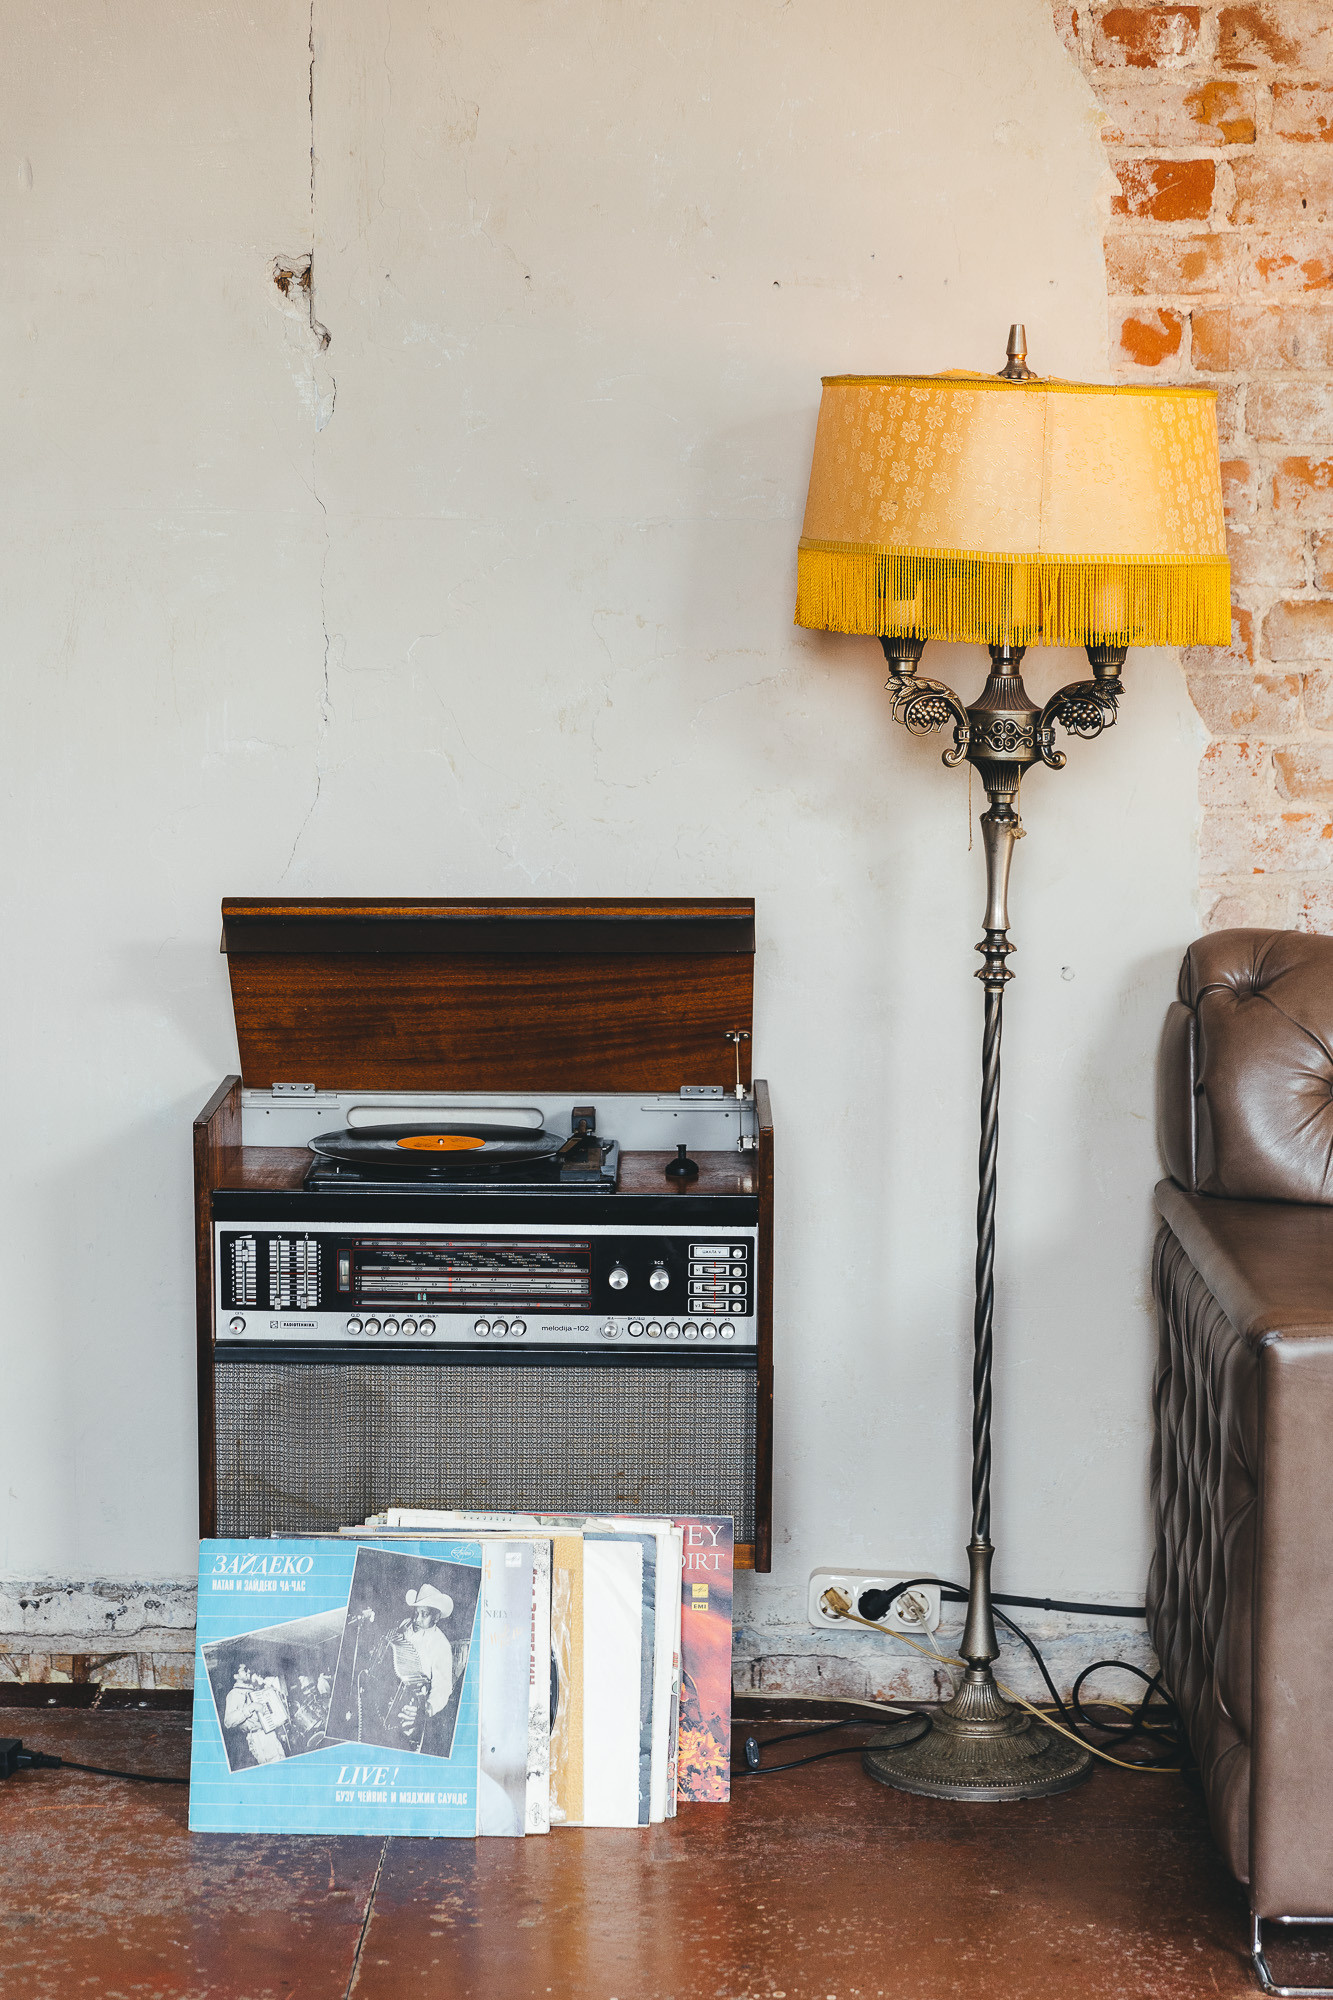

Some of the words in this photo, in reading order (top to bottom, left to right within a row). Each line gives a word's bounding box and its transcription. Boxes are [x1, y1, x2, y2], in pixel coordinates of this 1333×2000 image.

[212, 1553, 314, 1576] ЗАЙДЕКО
[212, 1579, 235, 1592] НАТАН
[236, 1580, 242, 1592] И
[244, 1578, 278, 1593] ЗАЙДЕКО
[280, 1580, 306, 1592] ЧА-ЧАС
[693, 1602, 708, 1610] EMI
[336, 1766, 400, 1786] LIVE!
[335, 1790, 355, 1803] БУЗУ
[358, 1789, 388, 1803] ЧЕЙВИС
[391, 1791, 397, 1804] И
[399, 1791, 436, 1805] МЭДЖИК
[438, 1792, 468, 1806] САУНДС
